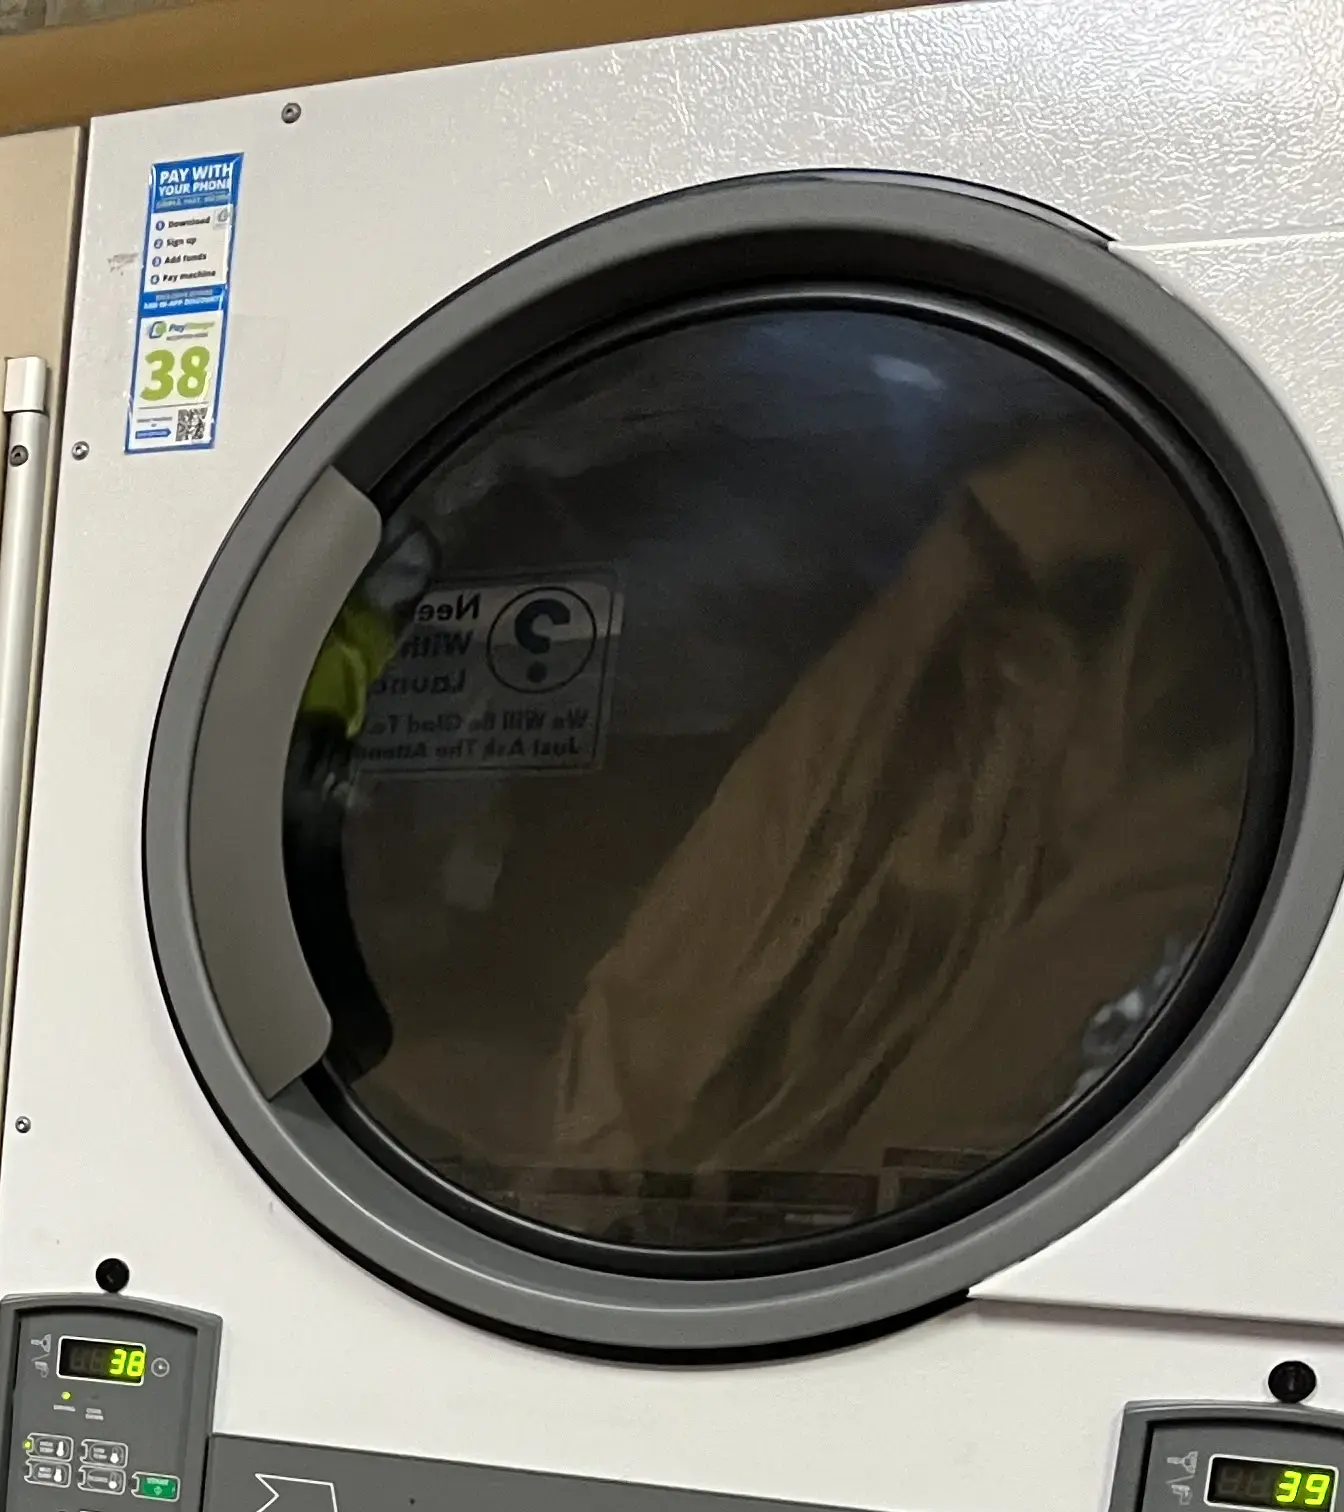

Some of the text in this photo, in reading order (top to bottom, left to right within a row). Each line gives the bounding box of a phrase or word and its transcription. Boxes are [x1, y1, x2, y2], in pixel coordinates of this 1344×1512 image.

[160, 163, 233, 185] PAY WITH
[158, 183, 190, 197] YOUR
[168, 216, 211, 228] Download
[166, 238, 184, 248] Sign
[186, 237, 197, 246] up
[164, 253, 207, 264] Add funds
[163, 274, 178, 283] Pay
[139, 345, 211, 401] 38
[109, 1348, 145, 1378] 38
[1276, 1470, 1330, 1506] 39
